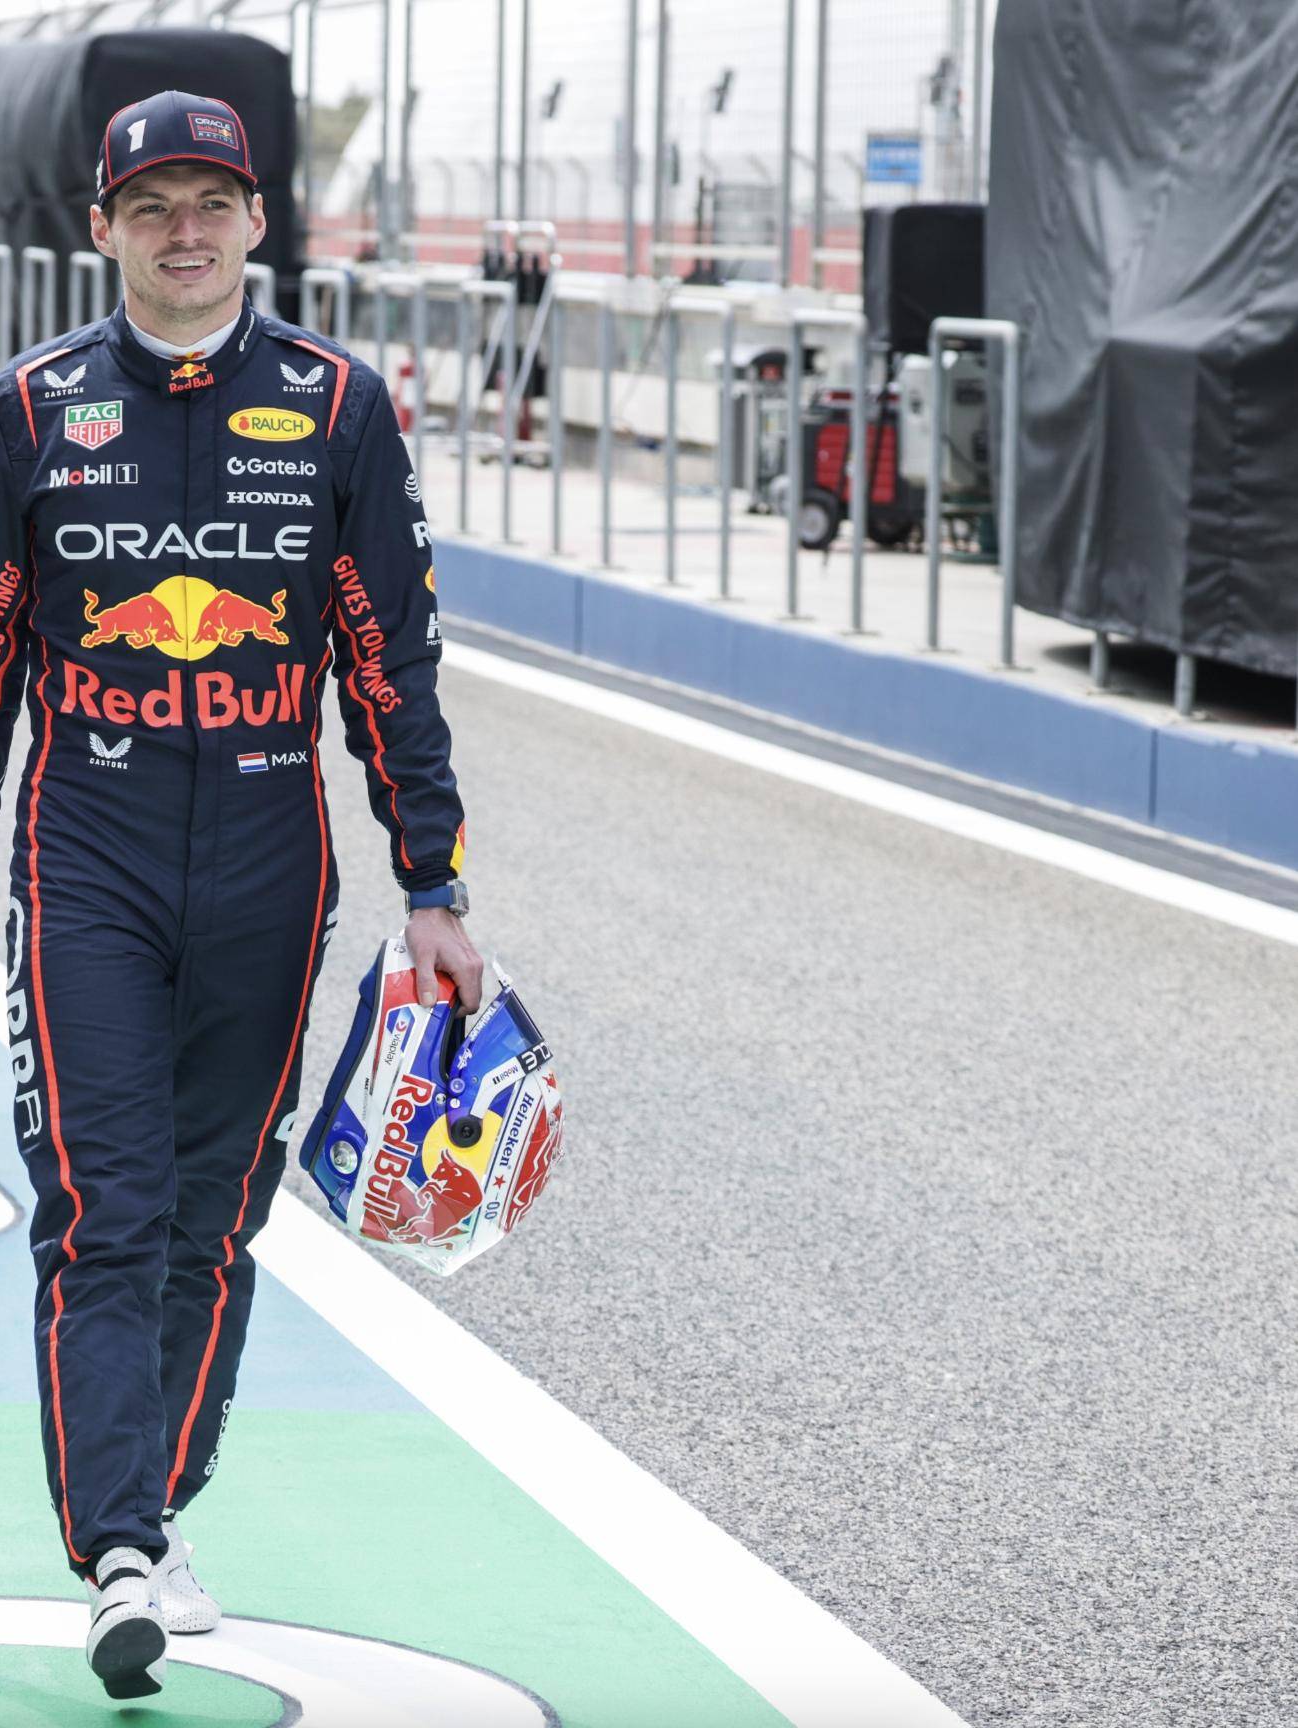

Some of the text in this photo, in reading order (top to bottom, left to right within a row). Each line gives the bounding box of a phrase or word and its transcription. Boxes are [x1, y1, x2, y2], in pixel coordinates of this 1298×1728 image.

[195, 117, 231, 131] ORACLE
[127, 118, 147, 153] 1
[44, 386, 84, 398] CASTORE
[168, 373, 214, 393] Red Bull
[283, 385, 324, 393] CASTORE
[70, 404, 118, 420] TAG
[251, 416, 304, 433] RAUCH
[69, 421, 121, 450] HEUER
[49, 464, 135, 488] Mobil 1
[246, 458, 317, 477] Gate.io
[227, 491, 314, 506] HONDA
[55, 522, 313, 560] ORACLE
[333, 554, 372, 616] GIVES
[360, 655, 403, 714] WINGS
[60, 659, 306, 730] Red Bull
[89, 758, 128, 770] CASTORE
[271, 750, 308, 767] MAX
[384, 1034, 400, 1066] viaplay
[499, 1092, 534, 1167] Heineken
[363, 1074, 434, 1220] Red Bull
